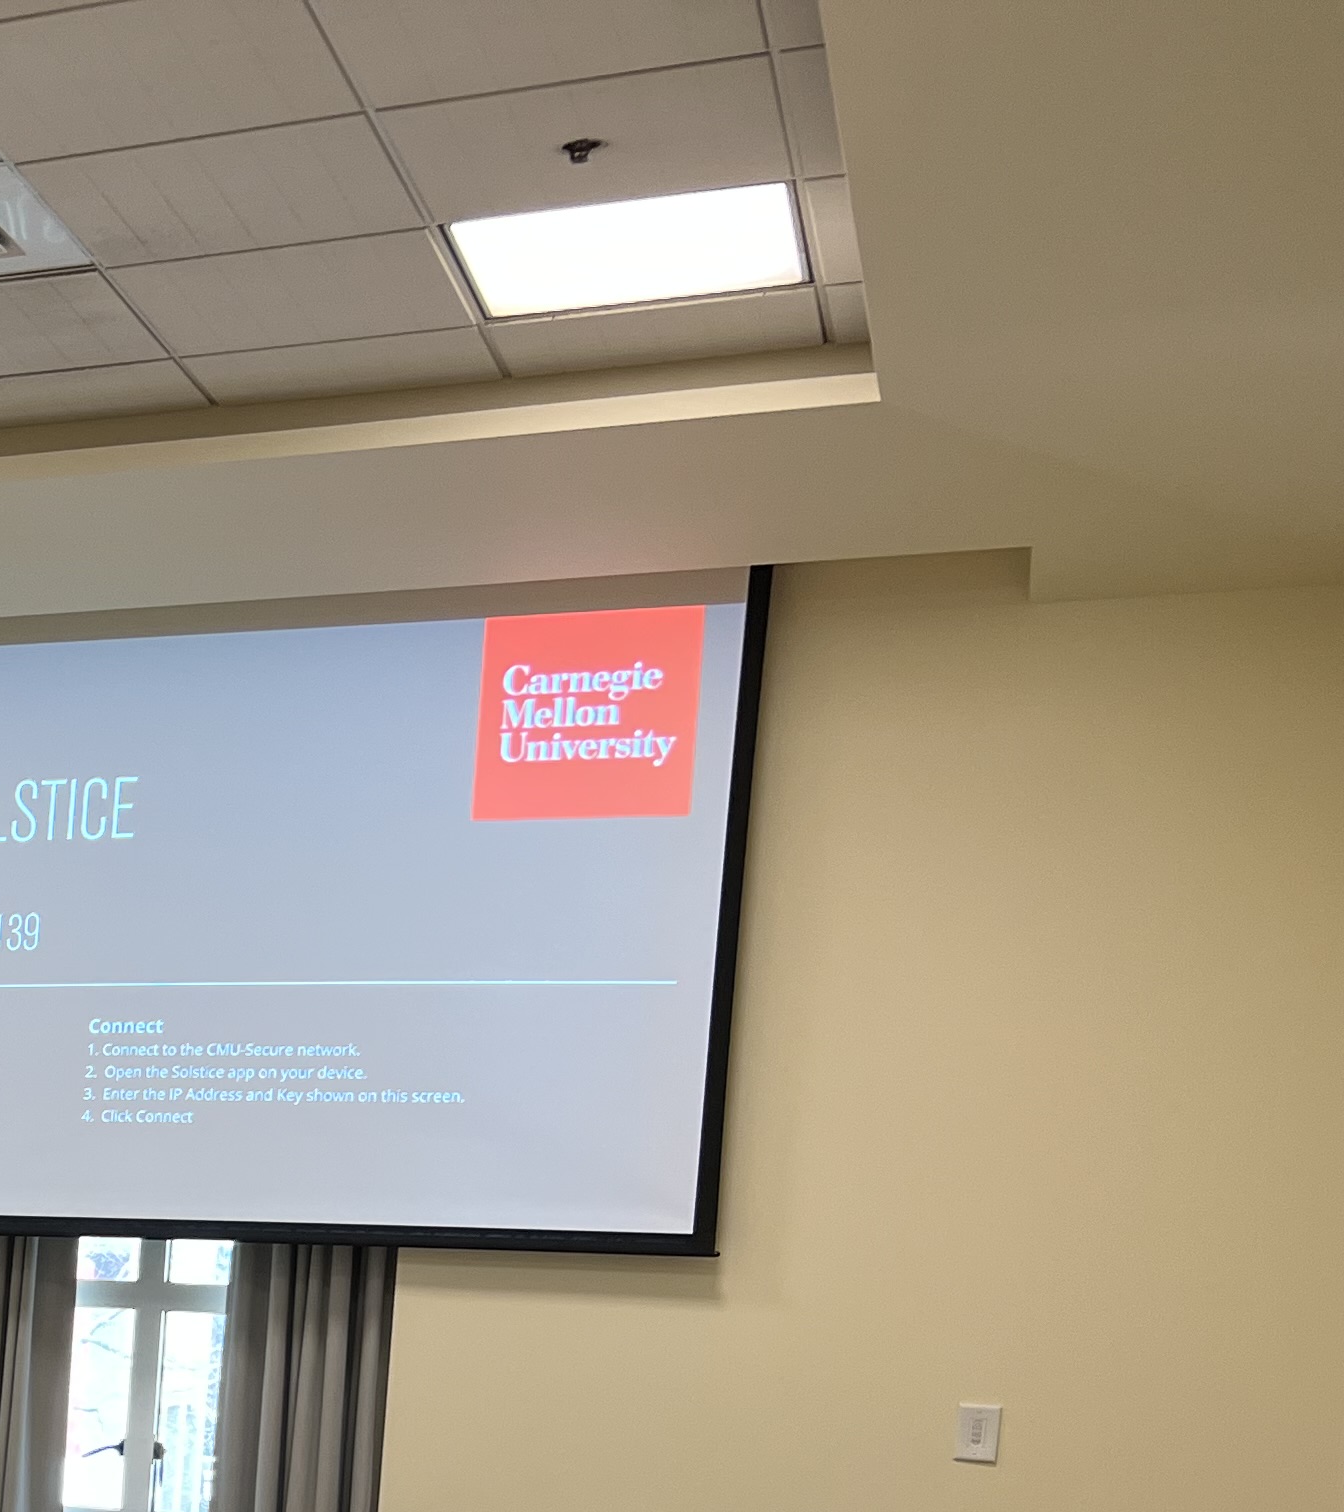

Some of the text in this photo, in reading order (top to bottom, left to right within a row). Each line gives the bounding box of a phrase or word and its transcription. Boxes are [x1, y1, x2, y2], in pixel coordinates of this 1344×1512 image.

[502, 661, 664, 701] Carnegie
[500, 696, 620, 730] Mellon
[499, 729, 677, 767] University
[88, 1018, 165, 1034] Connect
[87, 1042, 361, 1057] 1. Connect to the CMU-Secure network.
[84, 1064, 368, 1083] 2. Open the Solstice app on your device.
[82, 1087, 466, 1106] 3. Enter the IP Address and Key shown on this screen.
[101, 1109, 134, 1123] Click
[135, 1109, 194, 1124] Connect
